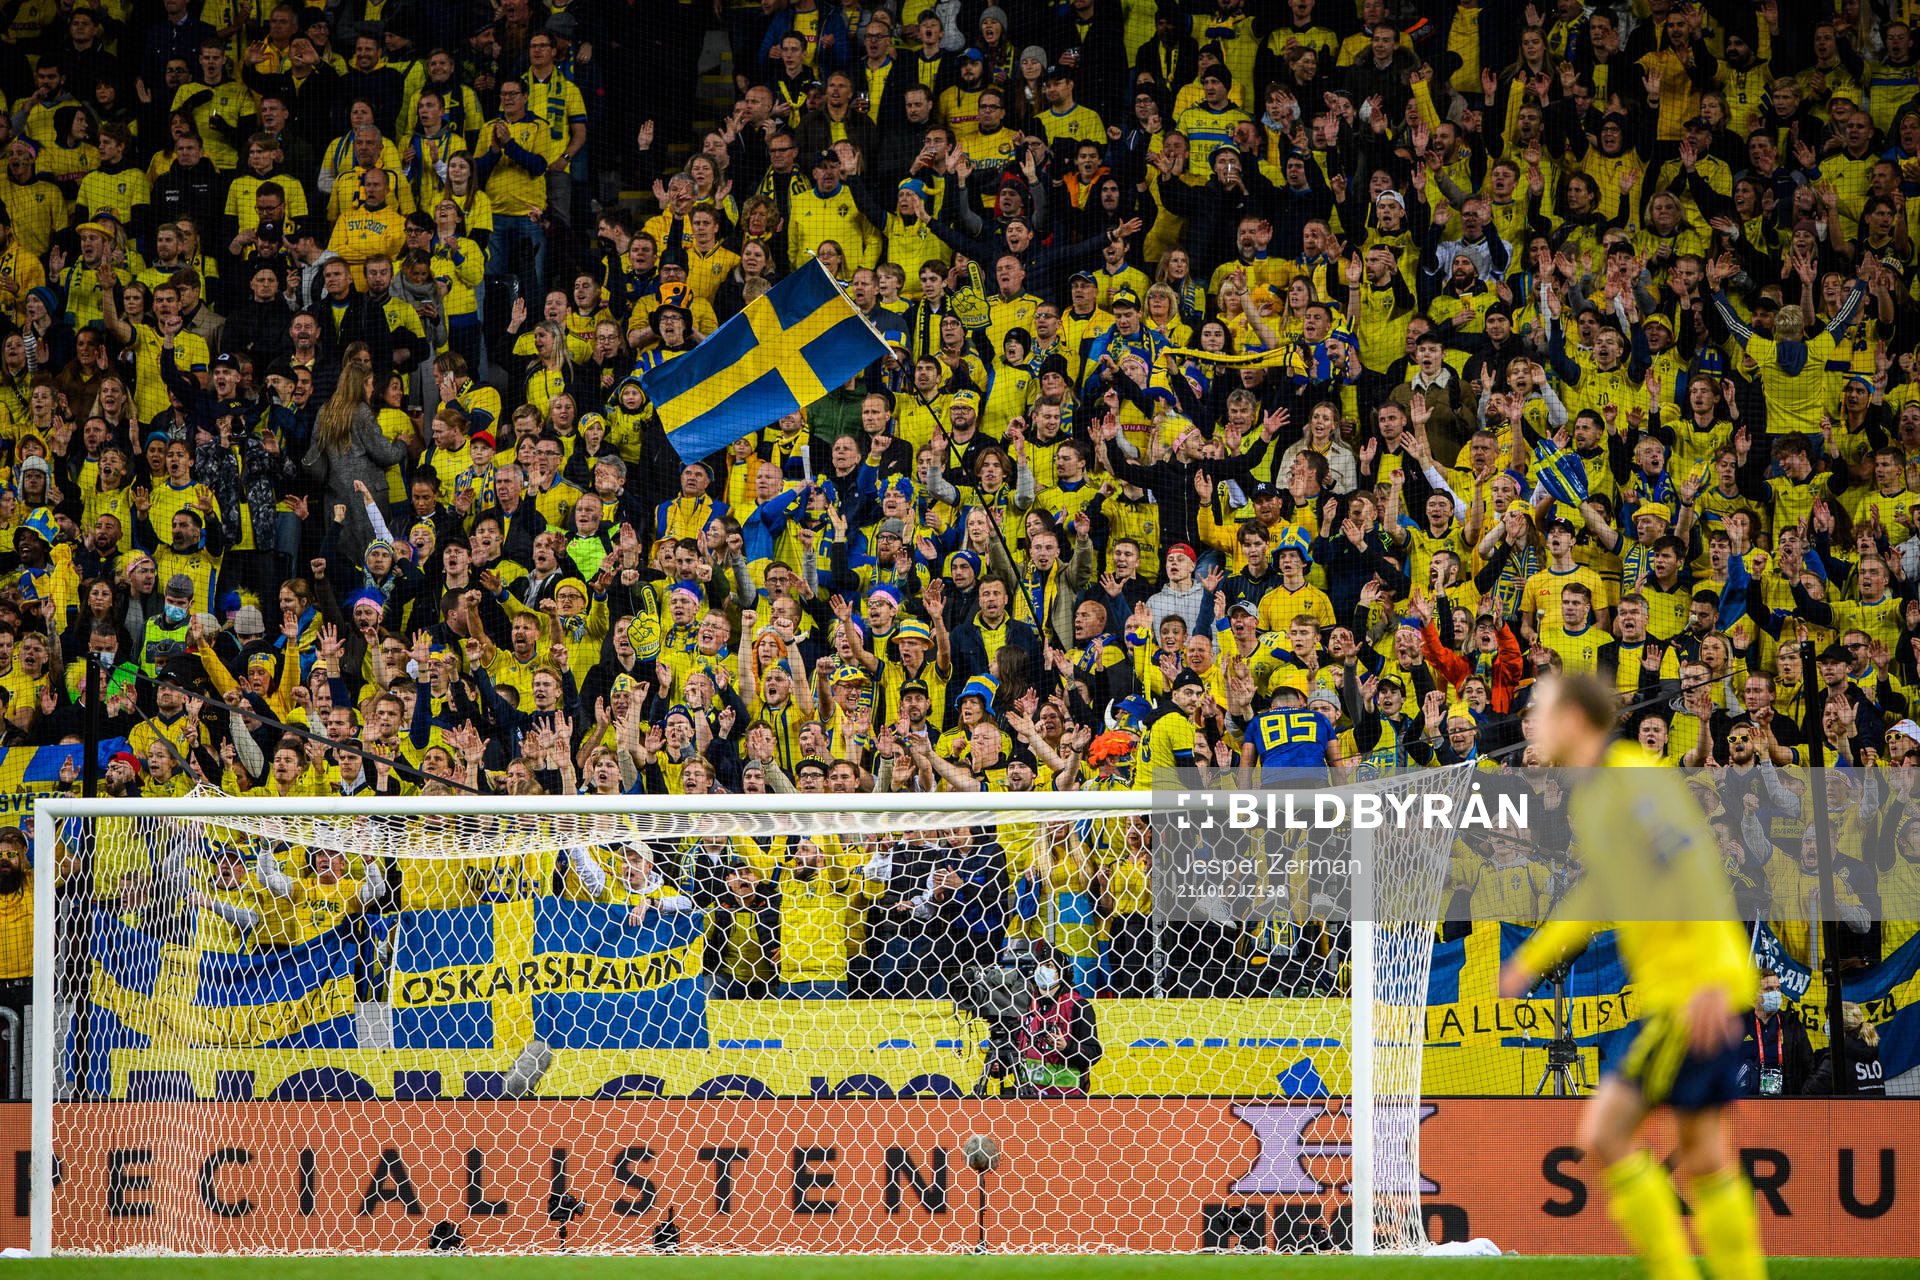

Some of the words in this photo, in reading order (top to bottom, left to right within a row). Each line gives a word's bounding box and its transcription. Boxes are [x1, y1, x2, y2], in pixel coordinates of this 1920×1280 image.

[1259, 713, 1318, 751] 85
[401, 947, 691, 1006] OSKARSHAMN
[1855, 1060, 1883, 1081] SLO
[1541, 1145, 1896, 1220] SRU
